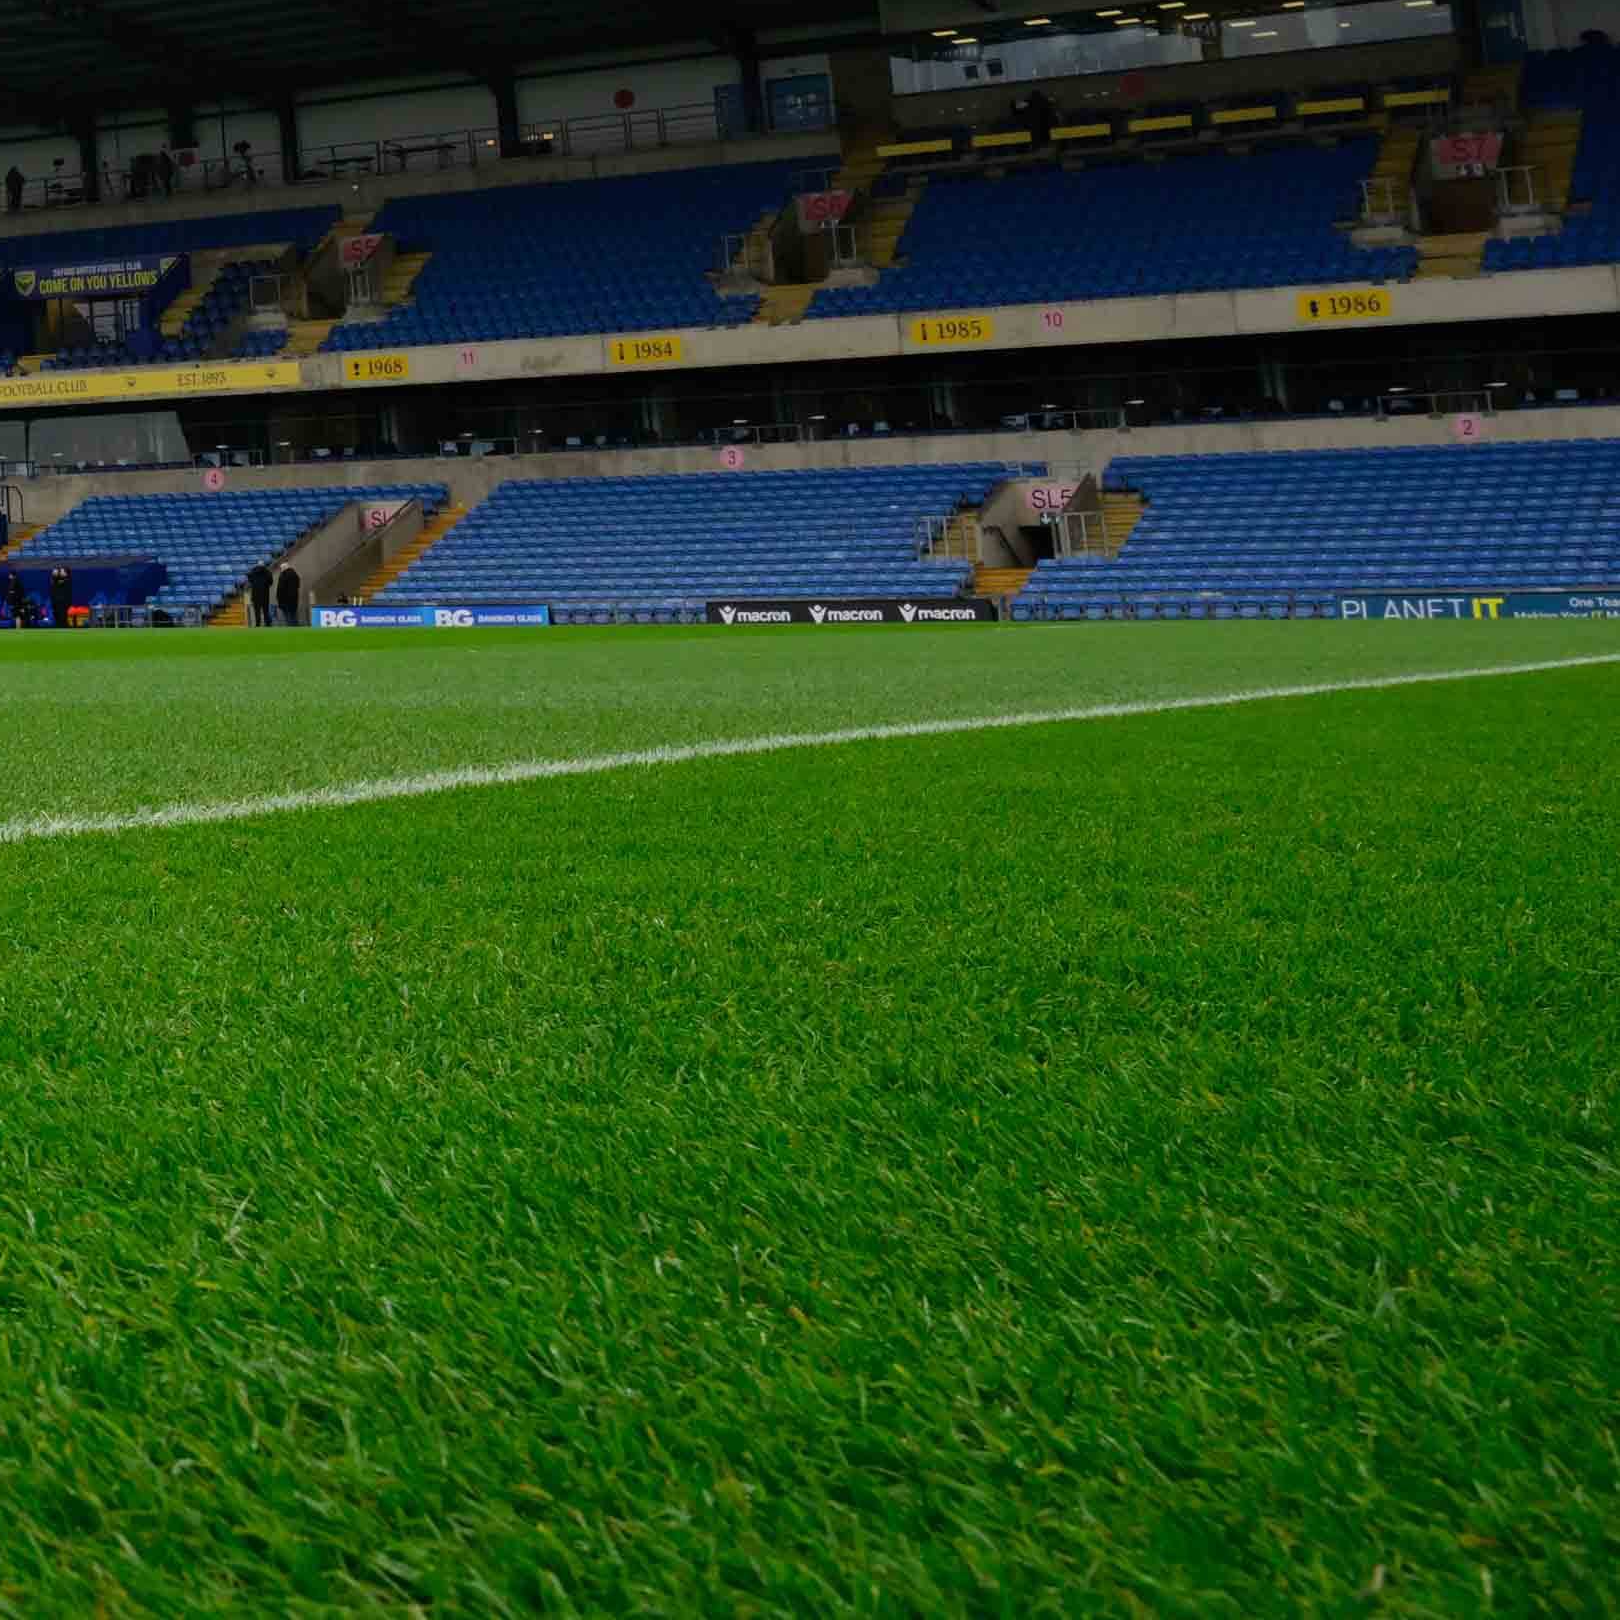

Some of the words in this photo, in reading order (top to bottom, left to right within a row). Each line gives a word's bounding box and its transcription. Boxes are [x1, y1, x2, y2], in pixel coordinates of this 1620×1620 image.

[40, 274, 69, 294] COME
[70, 274, 85, 292] ON
[87, 272, 107, 291] YOU
[109, 269, 158, 290] YELLOWS
[1329, 297, 1381, 315] 1986
[1044, 313, 1062, 327] 10
[936, 322, 982, 340] 1985
[632, 341, 673, 359] 1984
[369, 361, 403, 378] 1968
[1463, 420, 1472, 435] 2
[728, 451, 736, 465] 3
[1031, 489, 1073, 509] SL5
[1340, 598, 1464, 620] PLANET
[1470, 597, 1503, 621] IT
[1568, 597, 1593, 608] One
[1594, 597, 1620, 608] Tea
[319, 610, 358, 628] BG
[434, 610, 473, 627] BG
[737, 611, 791, 622] macron
[827, 610, 883, 621] macron
[917, 609, 975, 621] macron
